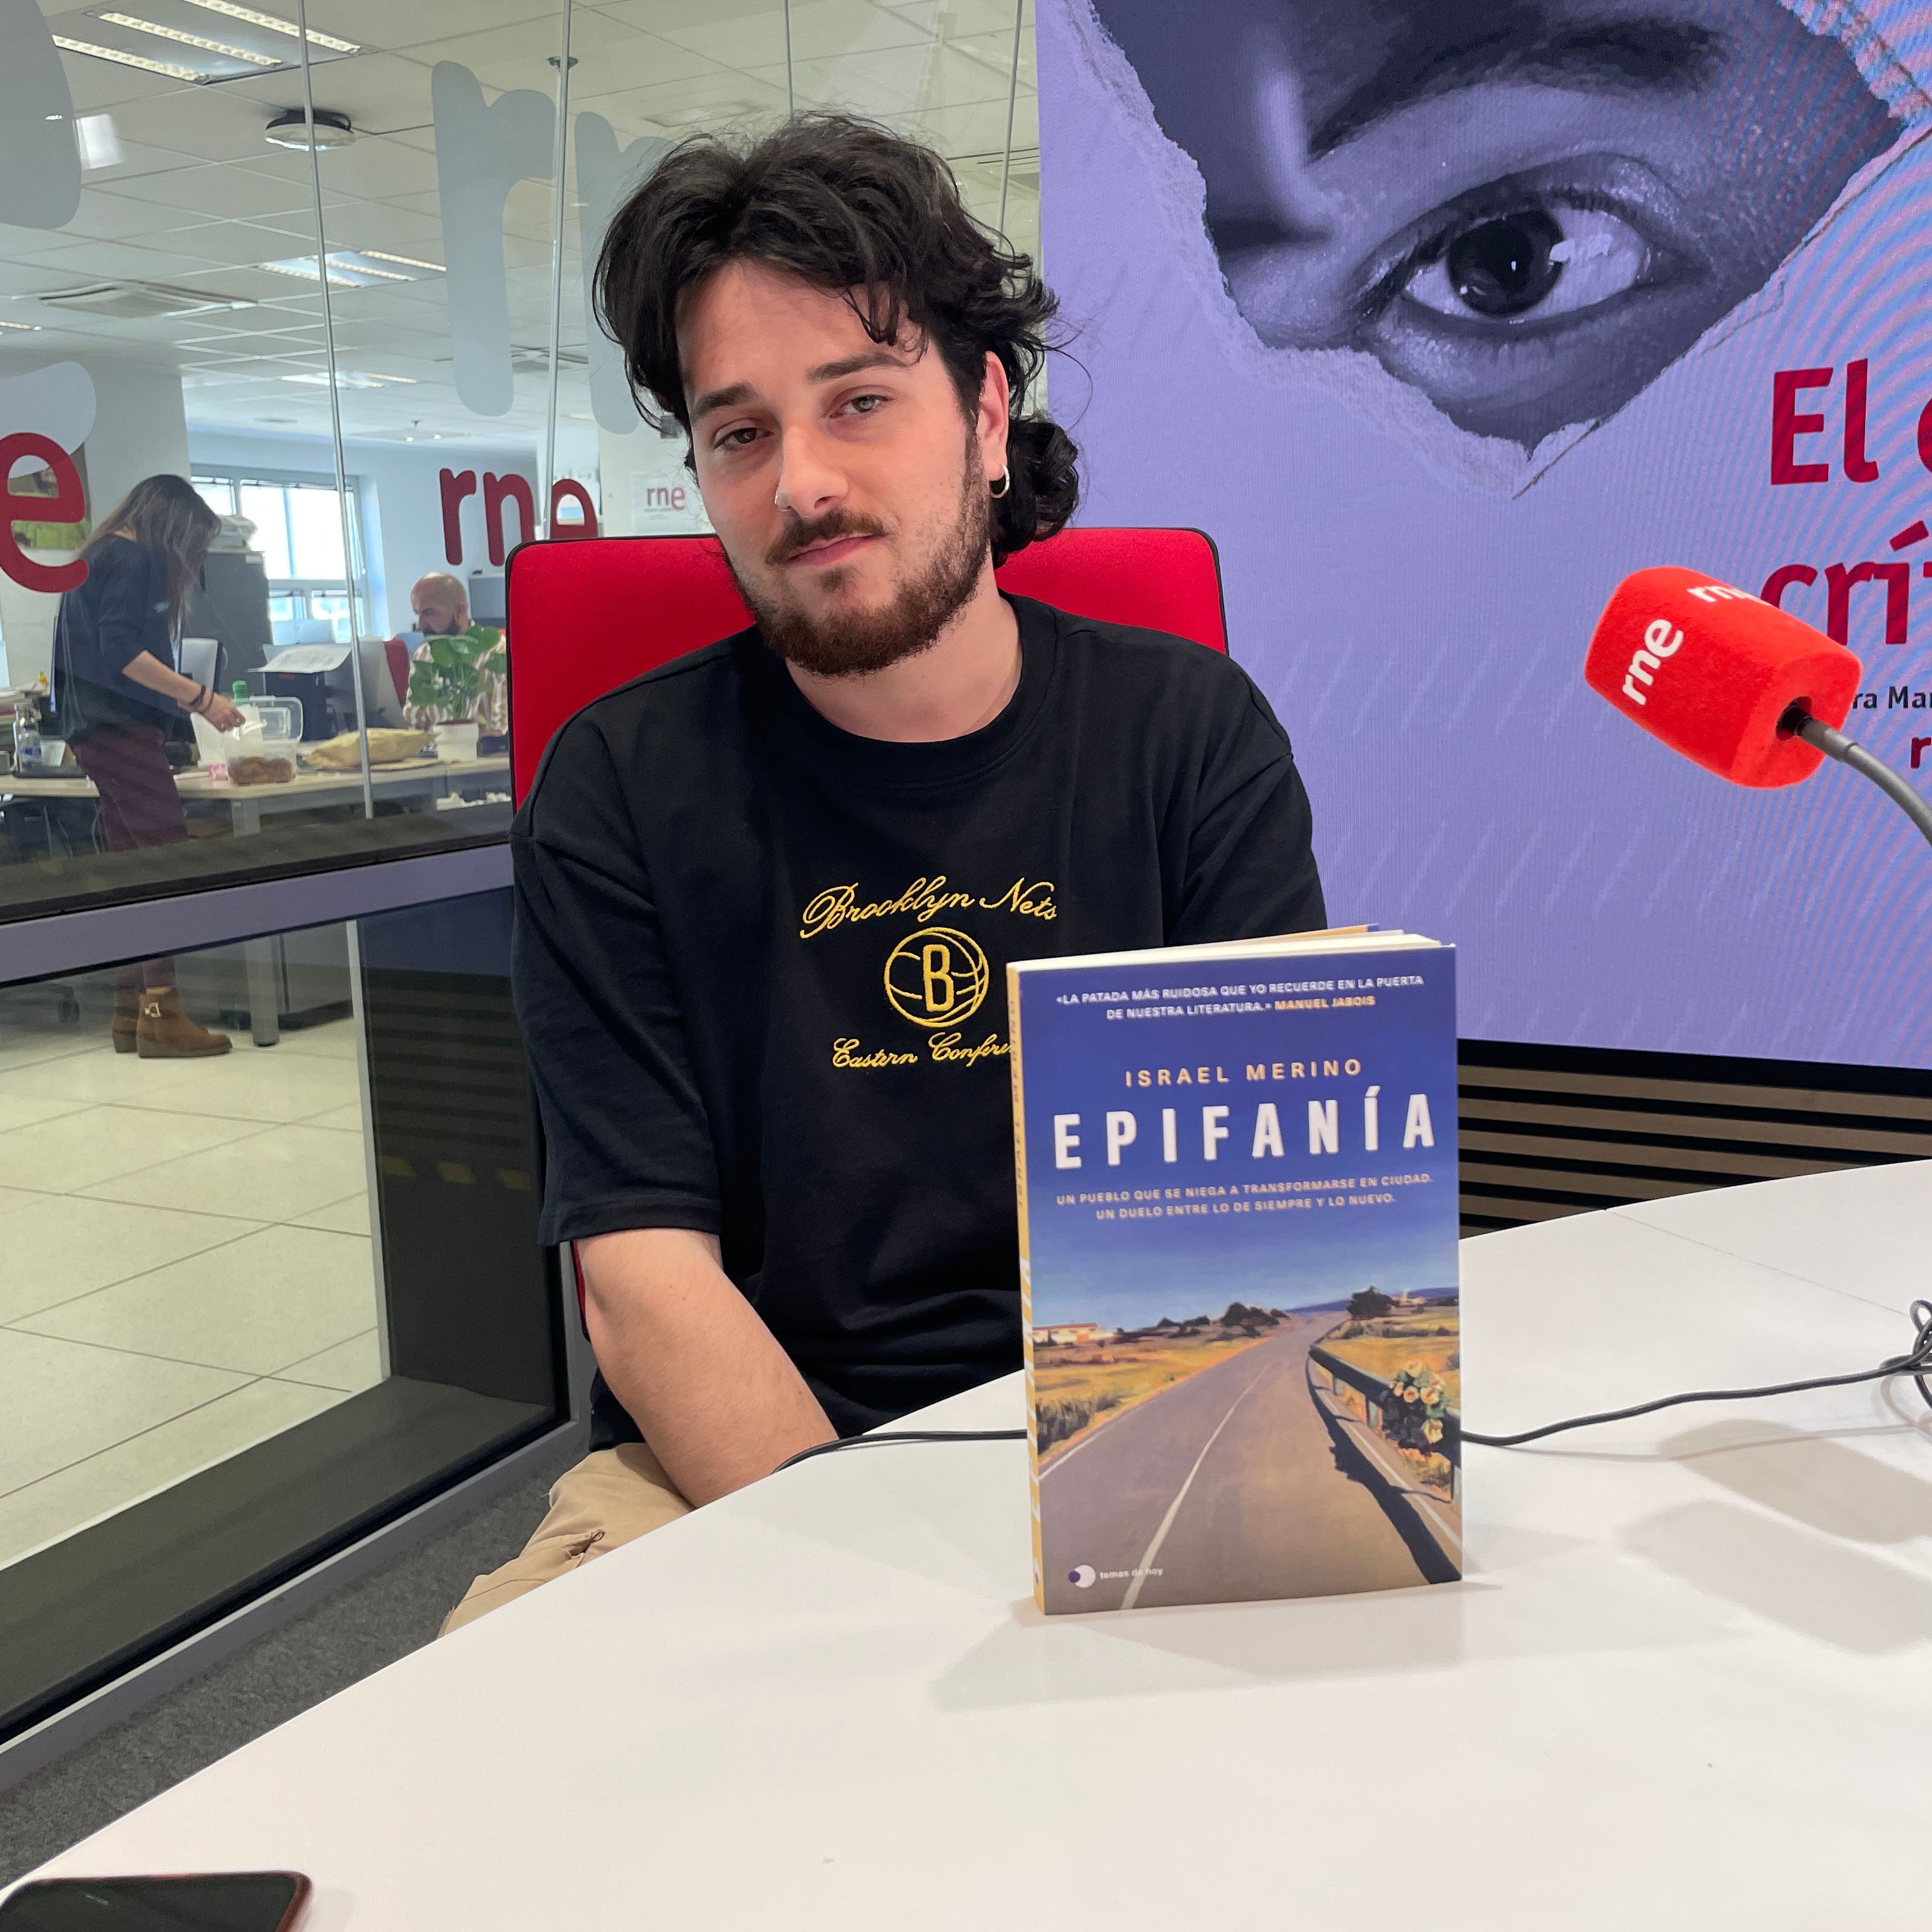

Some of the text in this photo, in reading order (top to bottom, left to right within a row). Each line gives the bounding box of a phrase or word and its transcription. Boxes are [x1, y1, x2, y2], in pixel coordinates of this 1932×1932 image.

[1770, 358, 1880, 486] El
[647, 486, 686, 511] rne
[1760, 521, 1932, 646] crí
[1622, 618, 1684, 706] rne
[1889, 686, 1932, 709] Ma
[800, 875, 1057, 939] Brooklyn Nets
[923, 944, 954, 1012] B
[1082, 991, 1130, 1004] PATADA
[1131, 987, 1160, 1001] MÁS
[1162, 986, 1218, 1000] RUIDOSA
[1220, 985, 1246, 996] QUE
[1249, 984, 1267, 995] YO
[1269, 980, 1335, 993] RECUERDE
[1338, 979, 1355, 990] EN
[1358, 977, 1374, 989] LA
[1377, 975, 1424, 987] PUERTA
[1107, 1008, 1124, 1021] DE
[1126, 1006, 1184, 1019] NUESTRA
[1274, 998, 1328, 1011] MANUEL
[1331, 995, 1376, 1008] JABOIS
[832, 1032, 1011, 1068] Eastern Confere
[1125, 1058, 1363, 1087] ISRAEL MERINO
[1053, 1085, 1435, 1170] EPIFANÍA
[1056, 1194, 1075, 1206] UN
[1079, 1190, 1130, 1204] PUEBLO
[1134, 1189, 1161, 1200] QUE
[1165, 1188, 1181, 1199] SE
[1185, 1186, 1225, 1197] NIEGA
[1229, 1185, 1239, 1195] A
[1243, 1178, 1356, 1195] TRANSFORMARSE
[1360, 1177, 1377, 1188] EN
[1096, 1193, 1395, 1220] UN DUELO ENTRE LO DE SIEMPRE Y LO NUEVO.
[1100, 1570, 1130, 1579] temas
[1145, 1567, 1163, 1577] hoy
